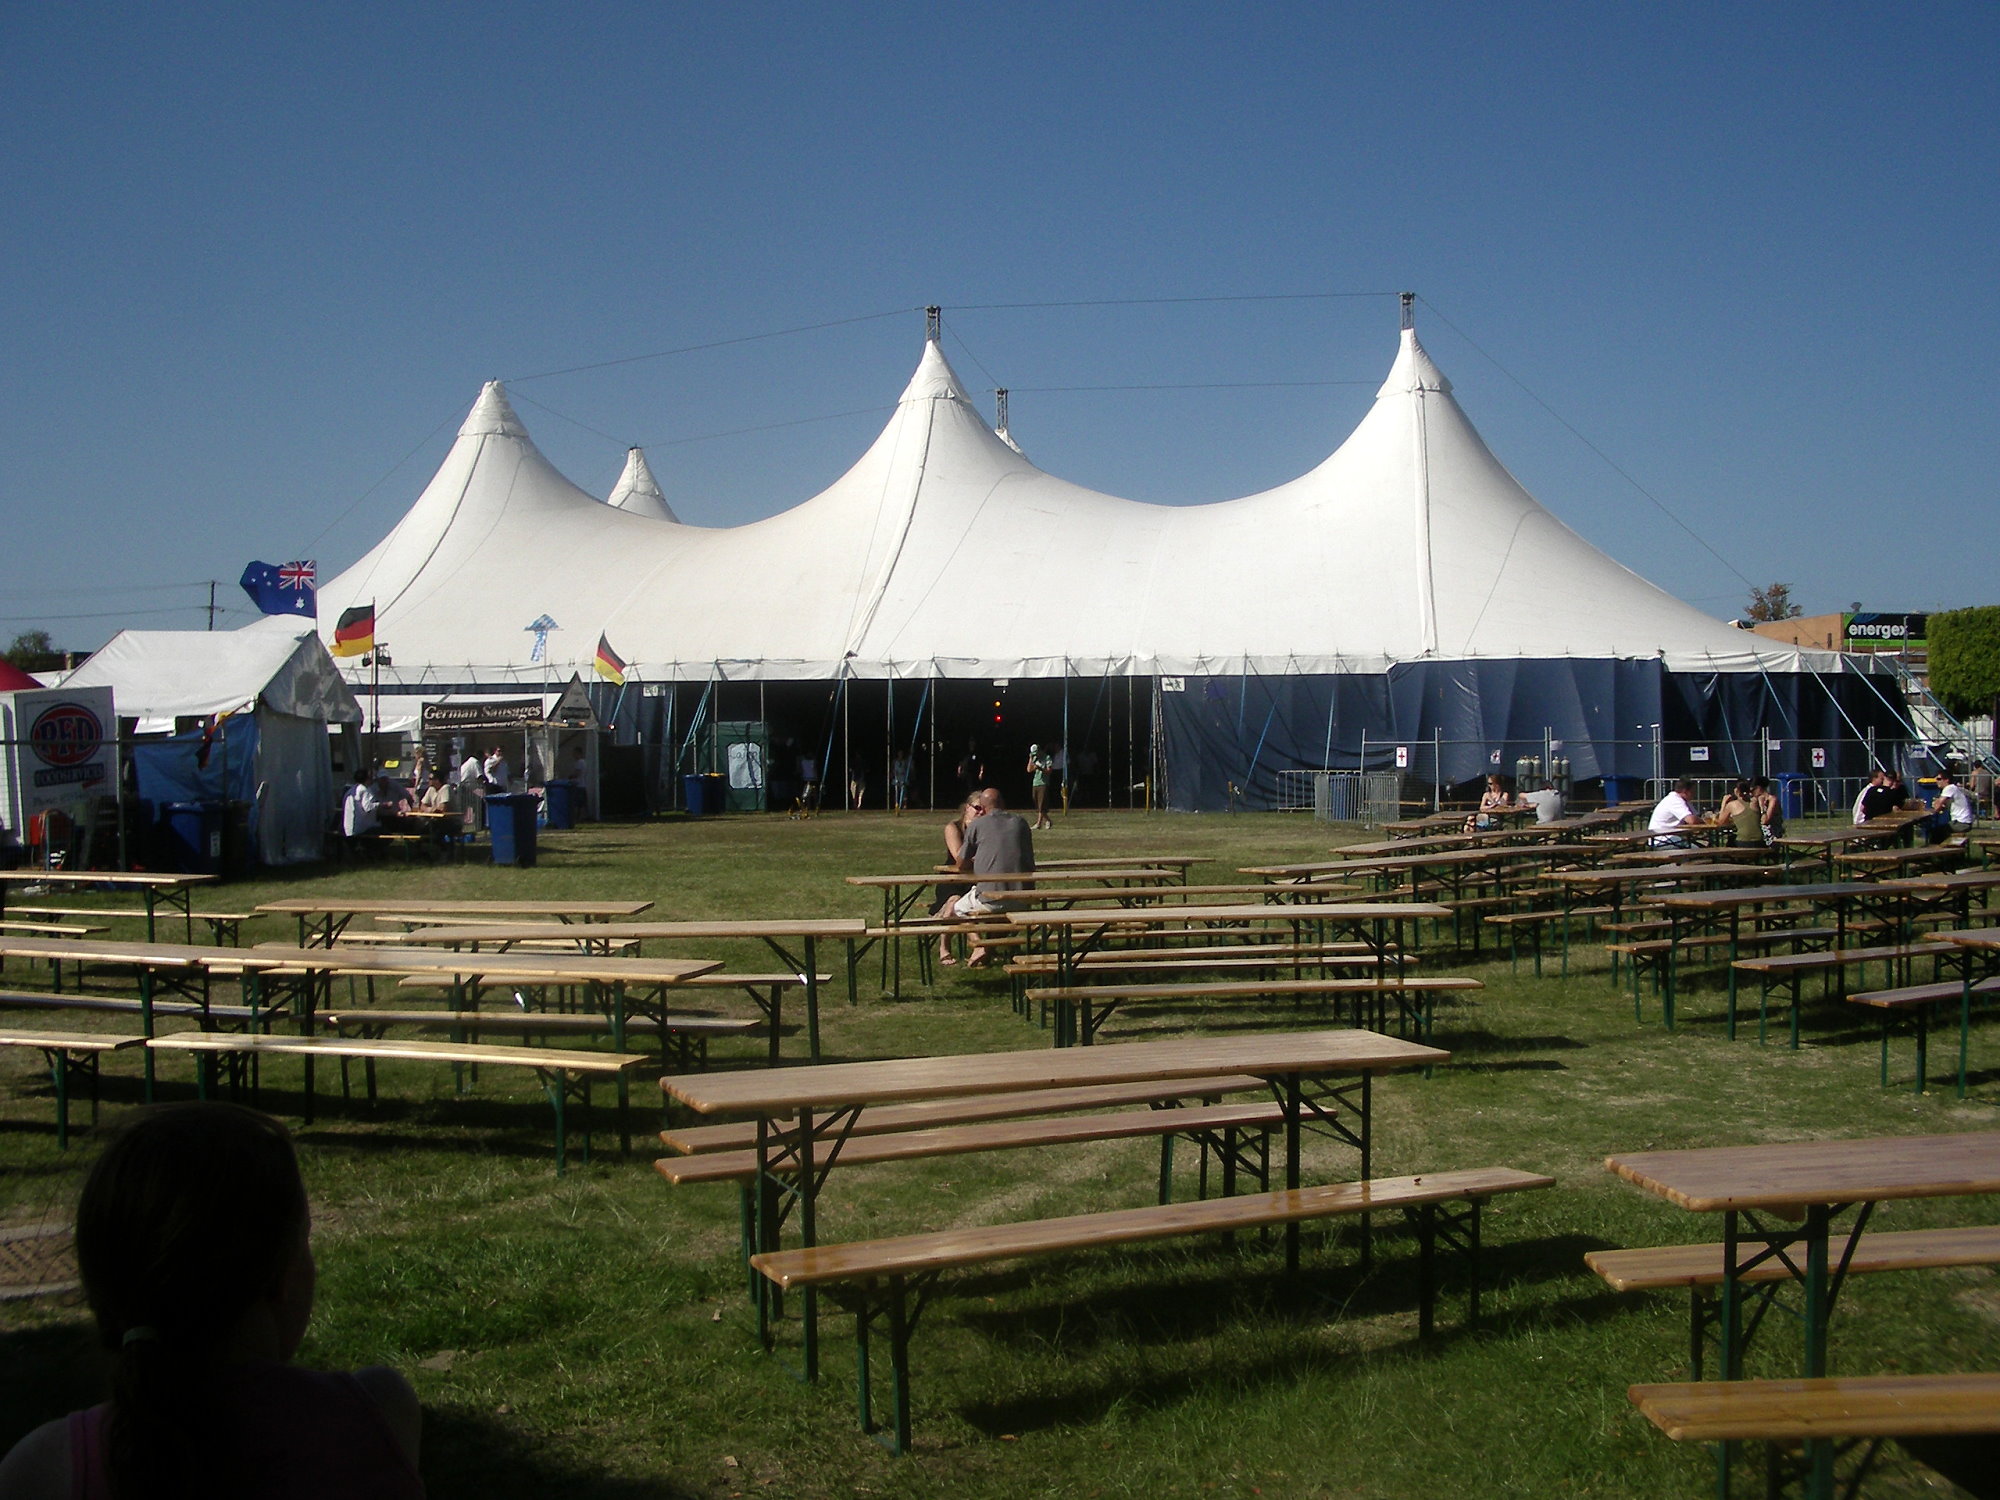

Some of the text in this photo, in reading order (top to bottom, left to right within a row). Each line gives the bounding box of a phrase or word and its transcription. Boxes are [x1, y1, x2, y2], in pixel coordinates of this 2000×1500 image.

[1849, 624, 1908, 639] energex
[424, 705, 542, 720] German Sausages
